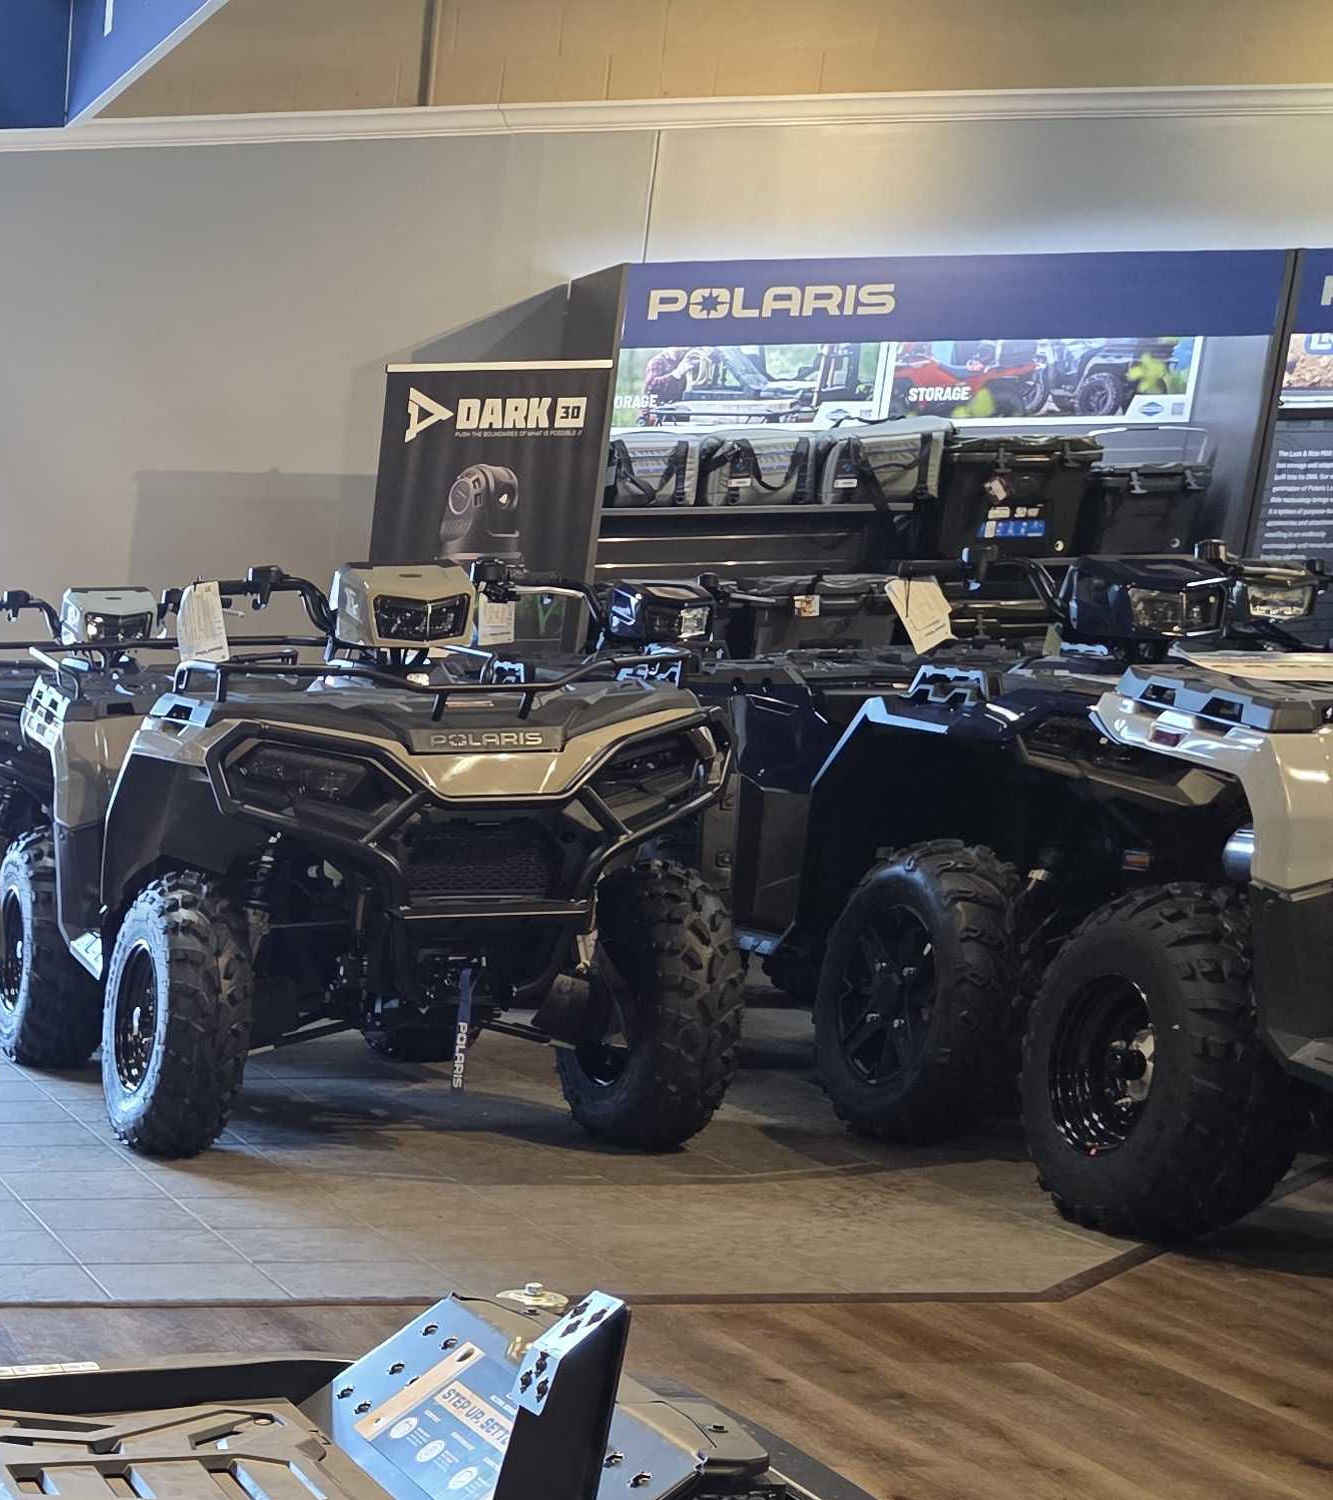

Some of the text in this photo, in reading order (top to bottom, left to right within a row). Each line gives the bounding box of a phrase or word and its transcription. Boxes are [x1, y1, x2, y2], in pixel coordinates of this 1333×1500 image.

[647, 284, 895, 320] POLARIS
[614, 394, 658, 408] ORAGE
[908, 386, 971, 402] STORAGE
[455, 397, 552, 429] DARK
[429, 732, 543, 746] POLARIS
[453, 1022, 468, 1088] POLARIS
[441, 1388, 471, 1410] STEP
